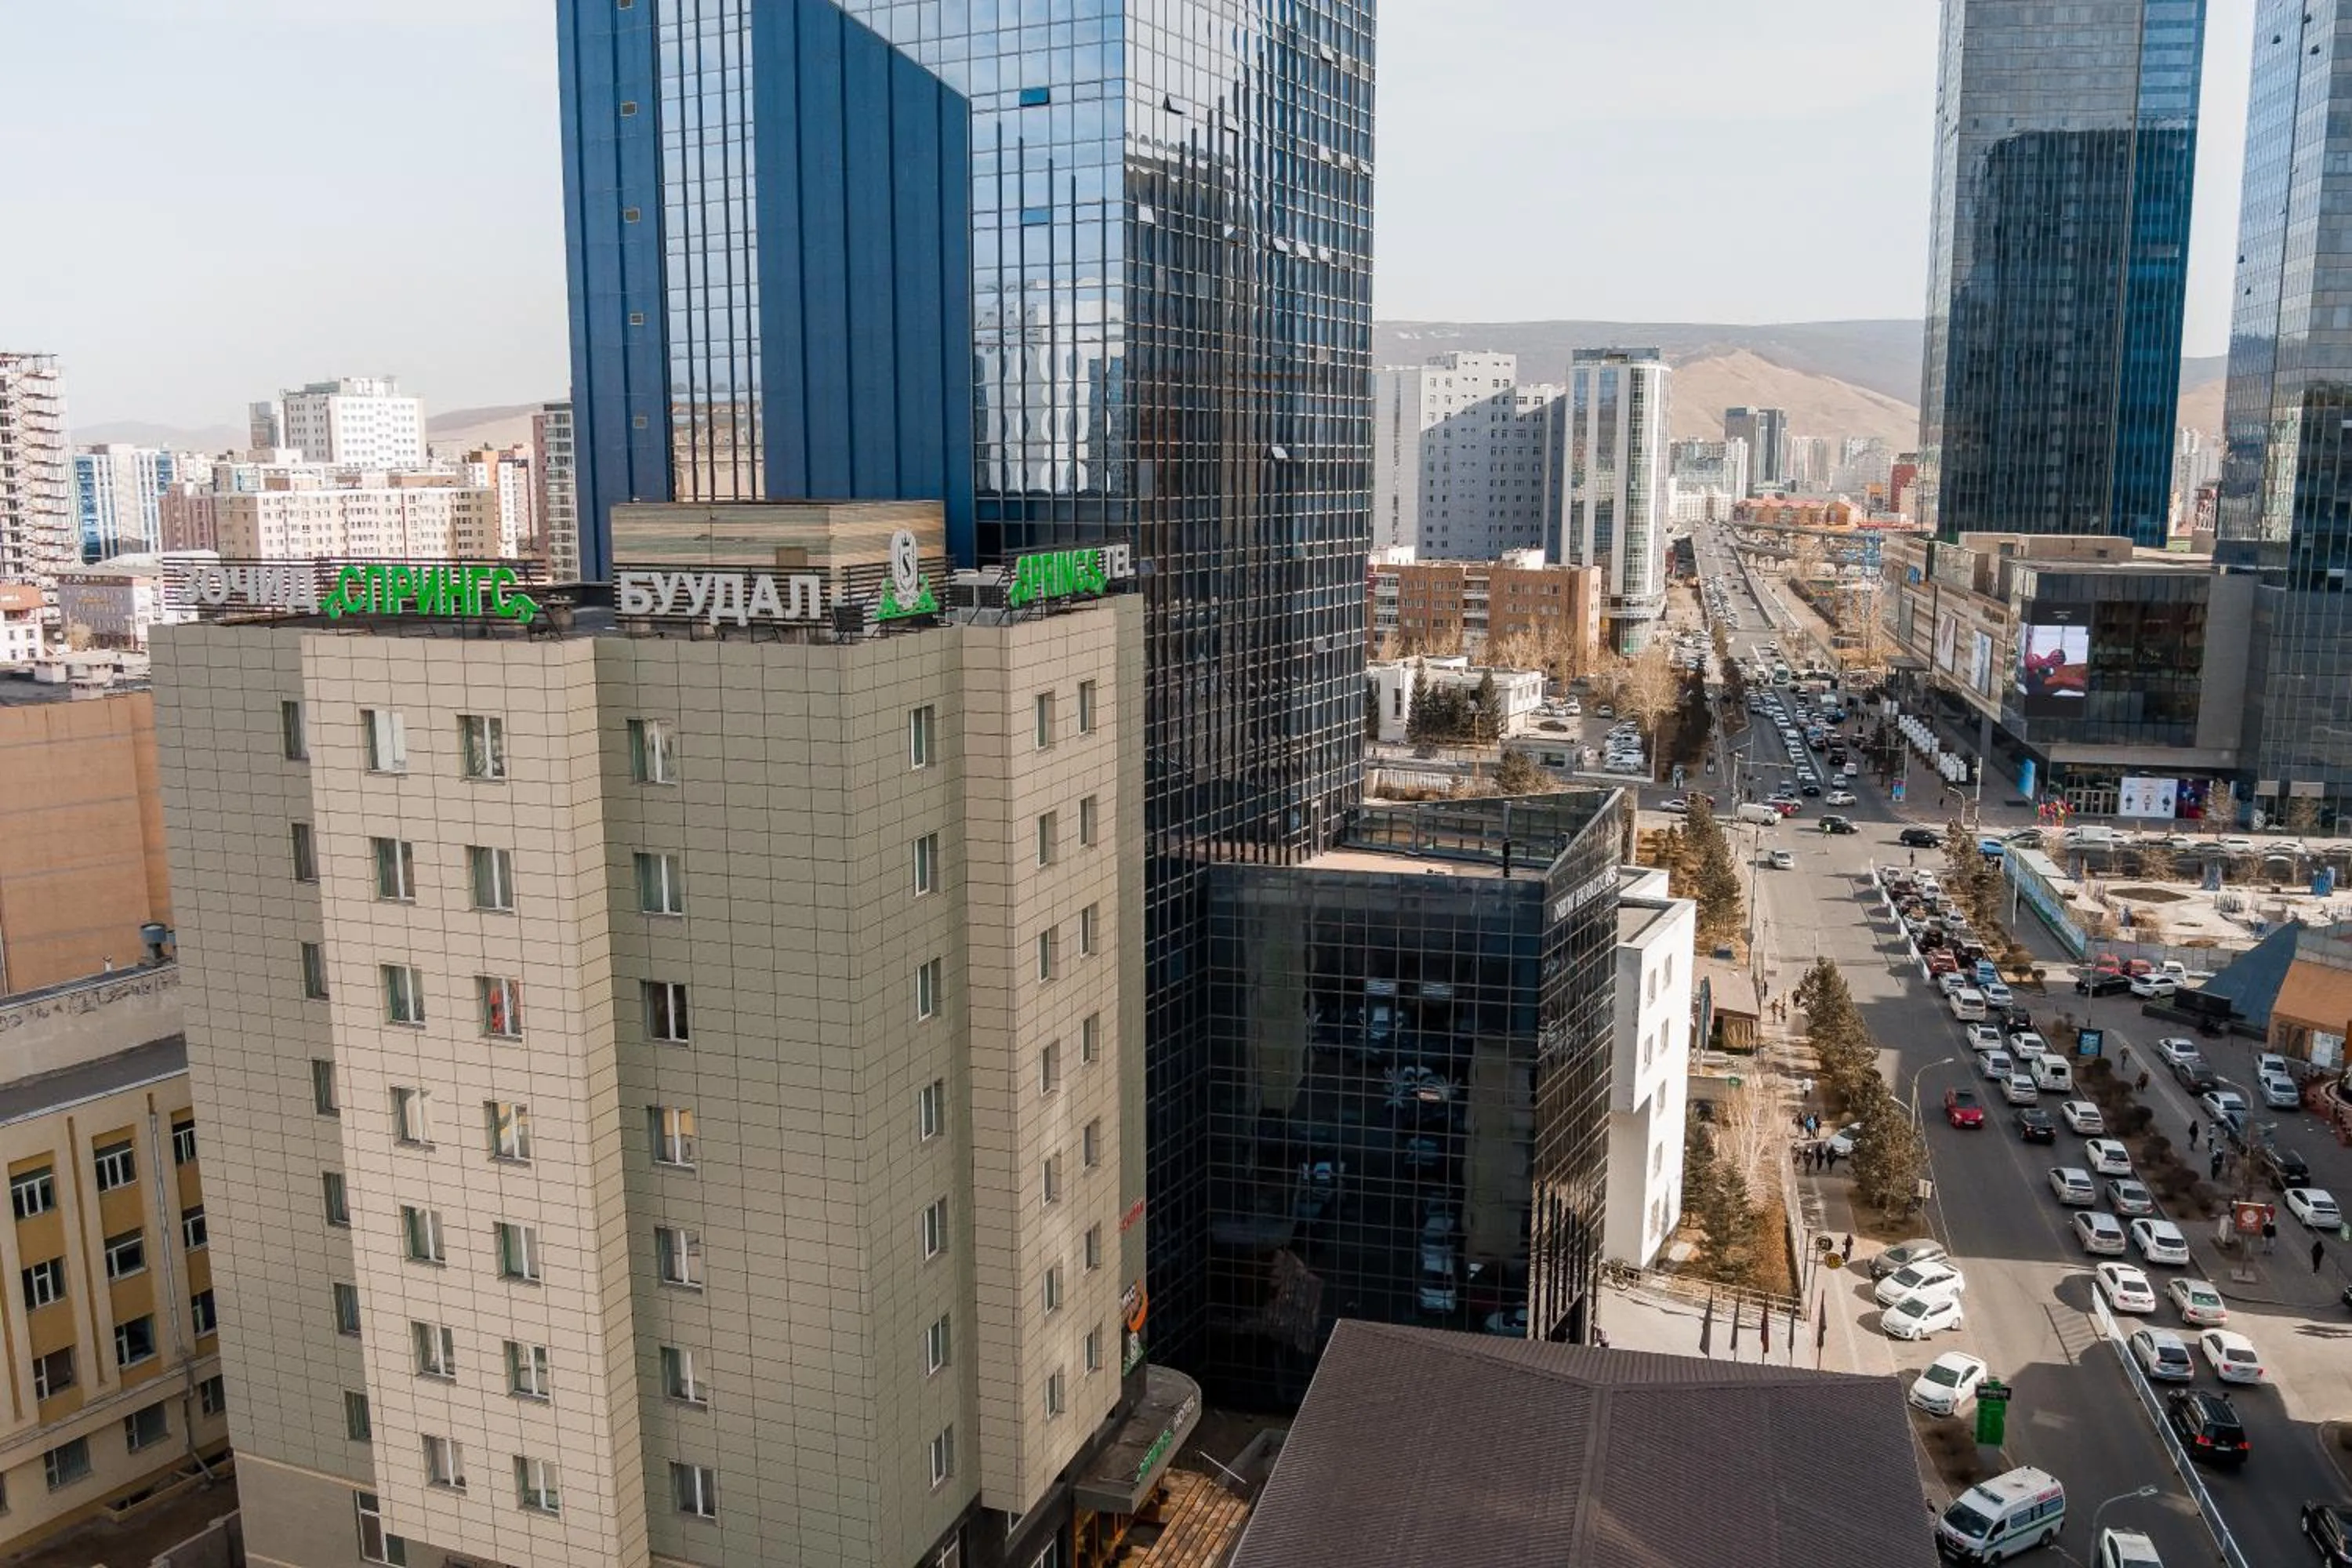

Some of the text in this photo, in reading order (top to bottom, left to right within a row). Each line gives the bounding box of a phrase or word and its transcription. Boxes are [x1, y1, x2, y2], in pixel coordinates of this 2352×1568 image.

[175, 562, 518, 618] ЗОЧИД СПРИНГС
[619, 571, 821, 626] БУУДАЛ
[1016, 543, 1136, 603] SPRINGS TEL
